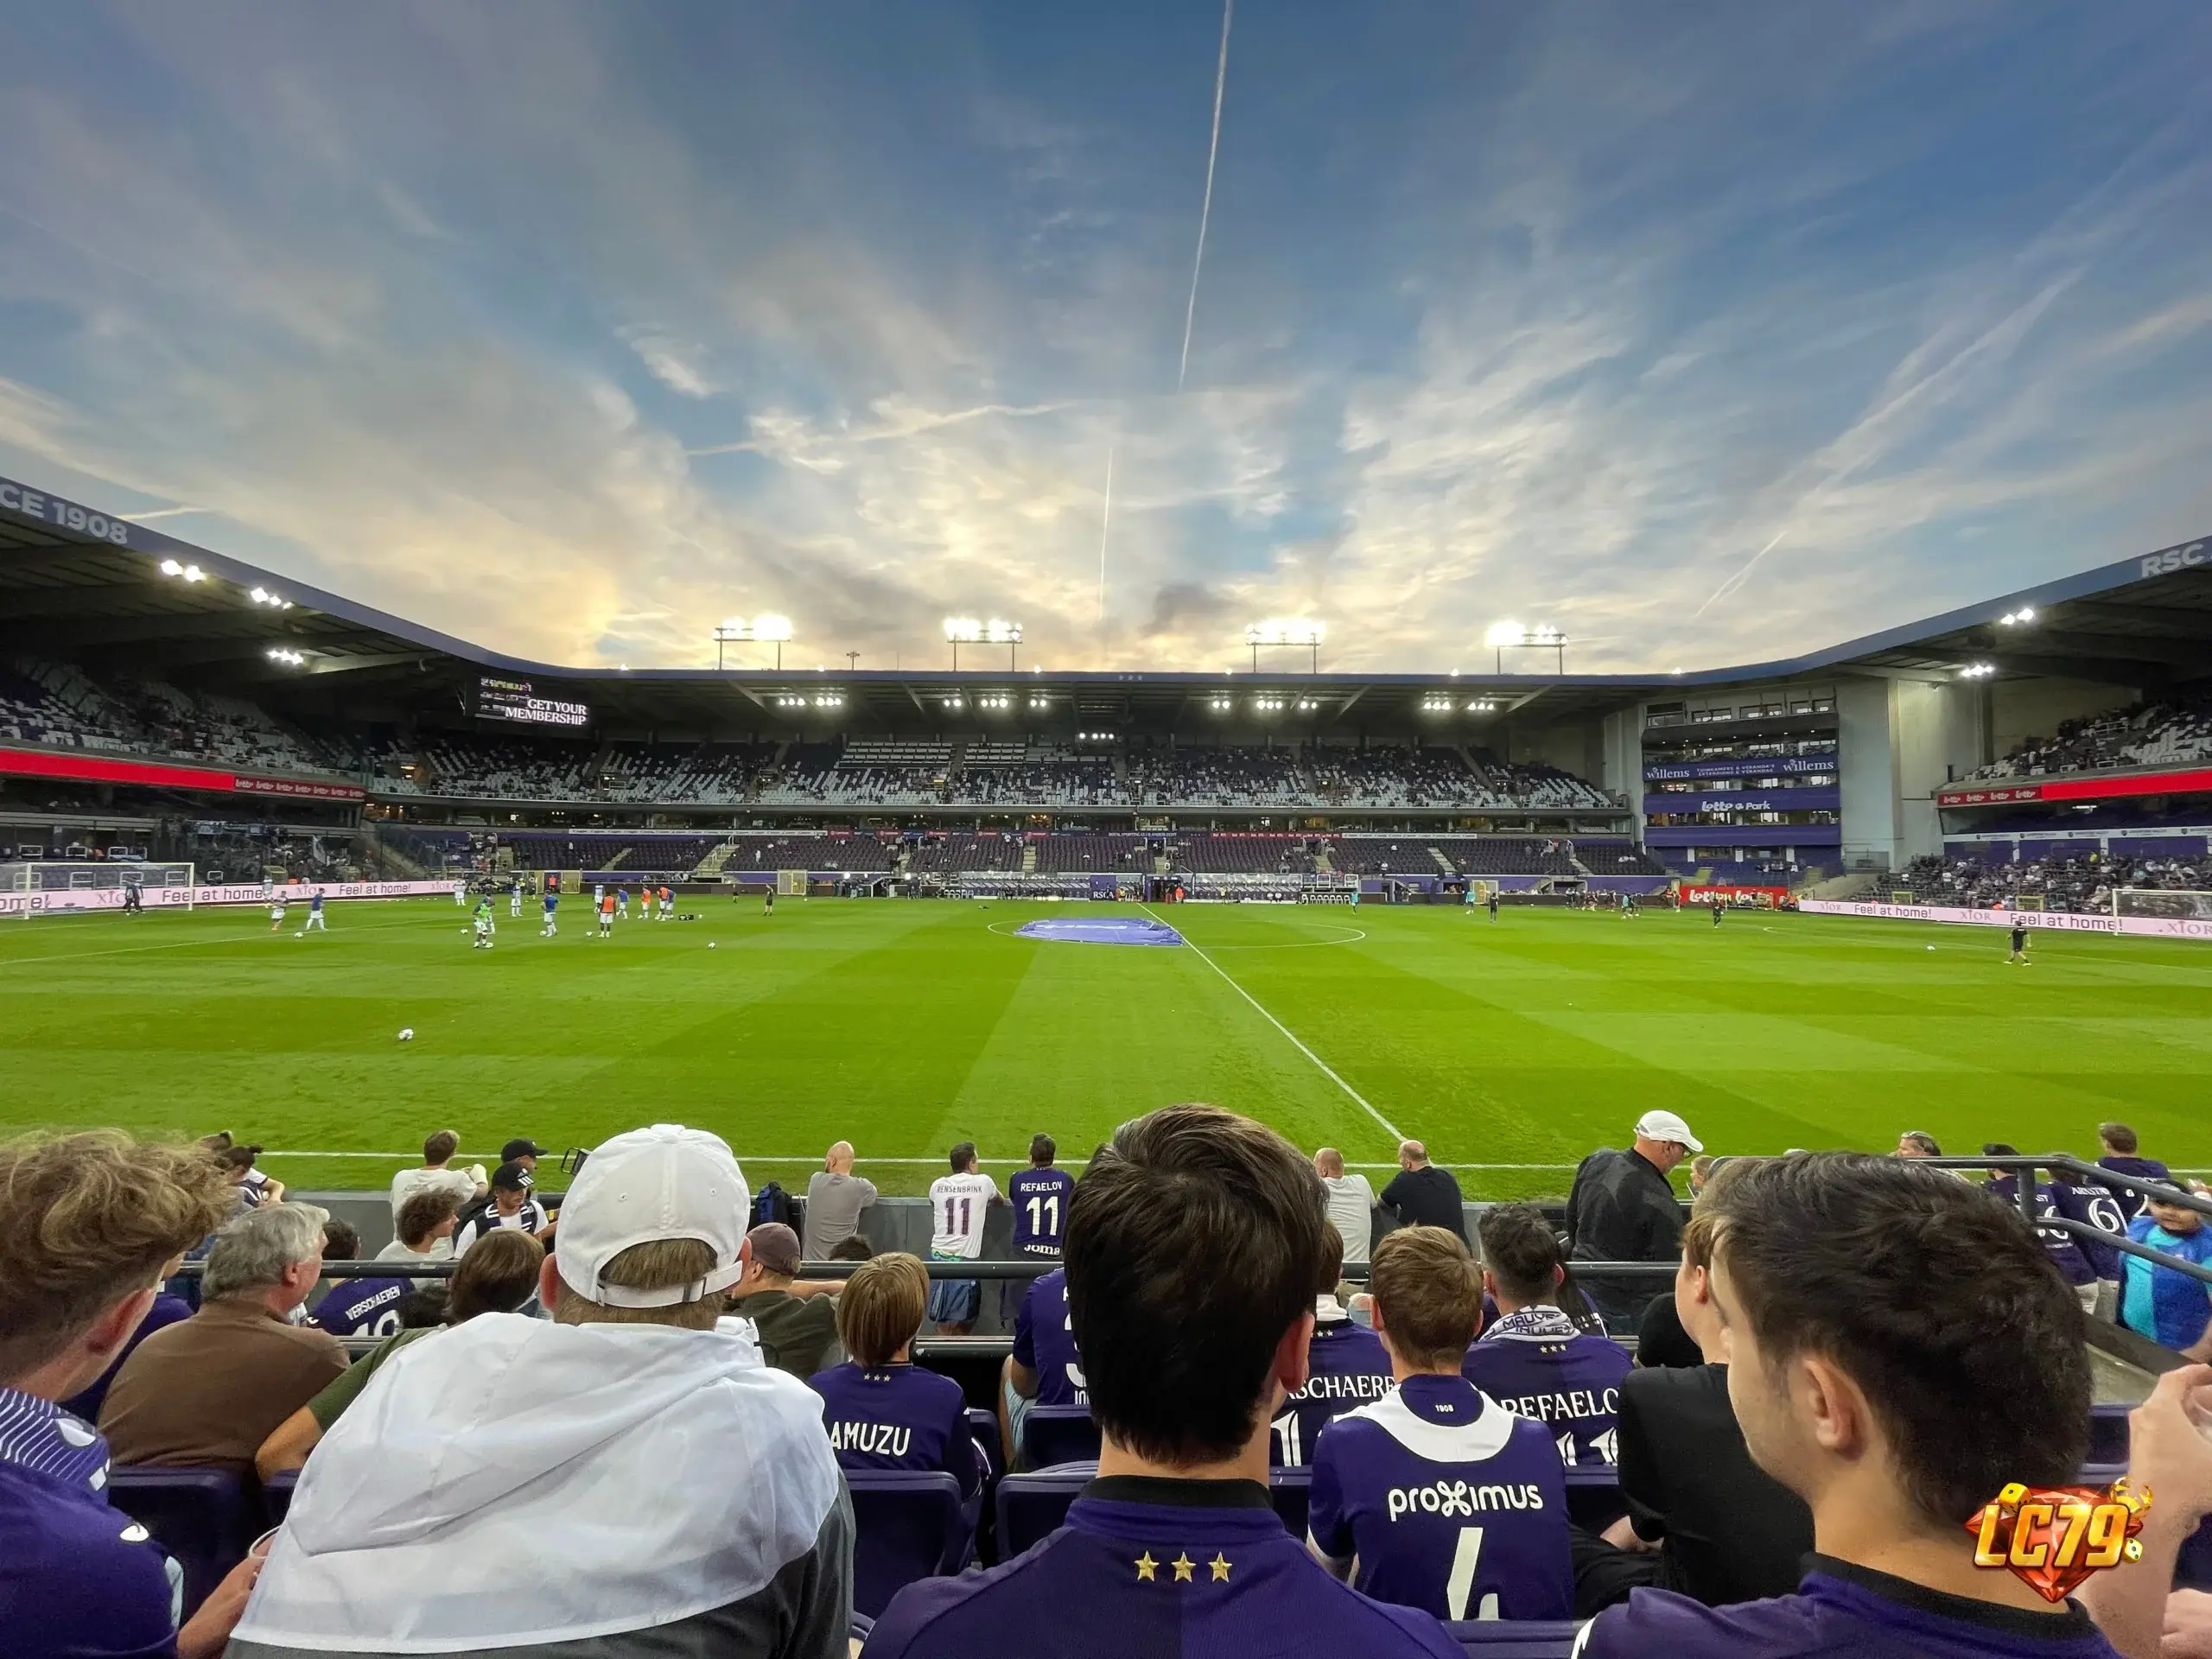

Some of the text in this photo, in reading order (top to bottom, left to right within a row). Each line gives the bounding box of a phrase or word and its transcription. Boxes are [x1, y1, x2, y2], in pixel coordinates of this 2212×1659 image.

[52, 502, 128, 544] 1908
[2142, 544, 2205, 578] RSC
[527, 698, 588, 715] GET YOUR
[505, 707, 587, 725] MEMBERSHIP
[1746, 800, 1771, 810] Park
[162, 887, 263, 902] Feel at home
[339, 882, 411, 895] Feel at home!
[1854, 904, 1932, 918] Feel at home!
[2010, 912, 2123, 931] Feel at home!
[1020, 1181, 1063, 1192] REFAELOV
[945, 1198, 972, 1236] 11
[1027, 1196, 1058, 1236] 11
[830, 1421, 911, 1456] AMUZU
